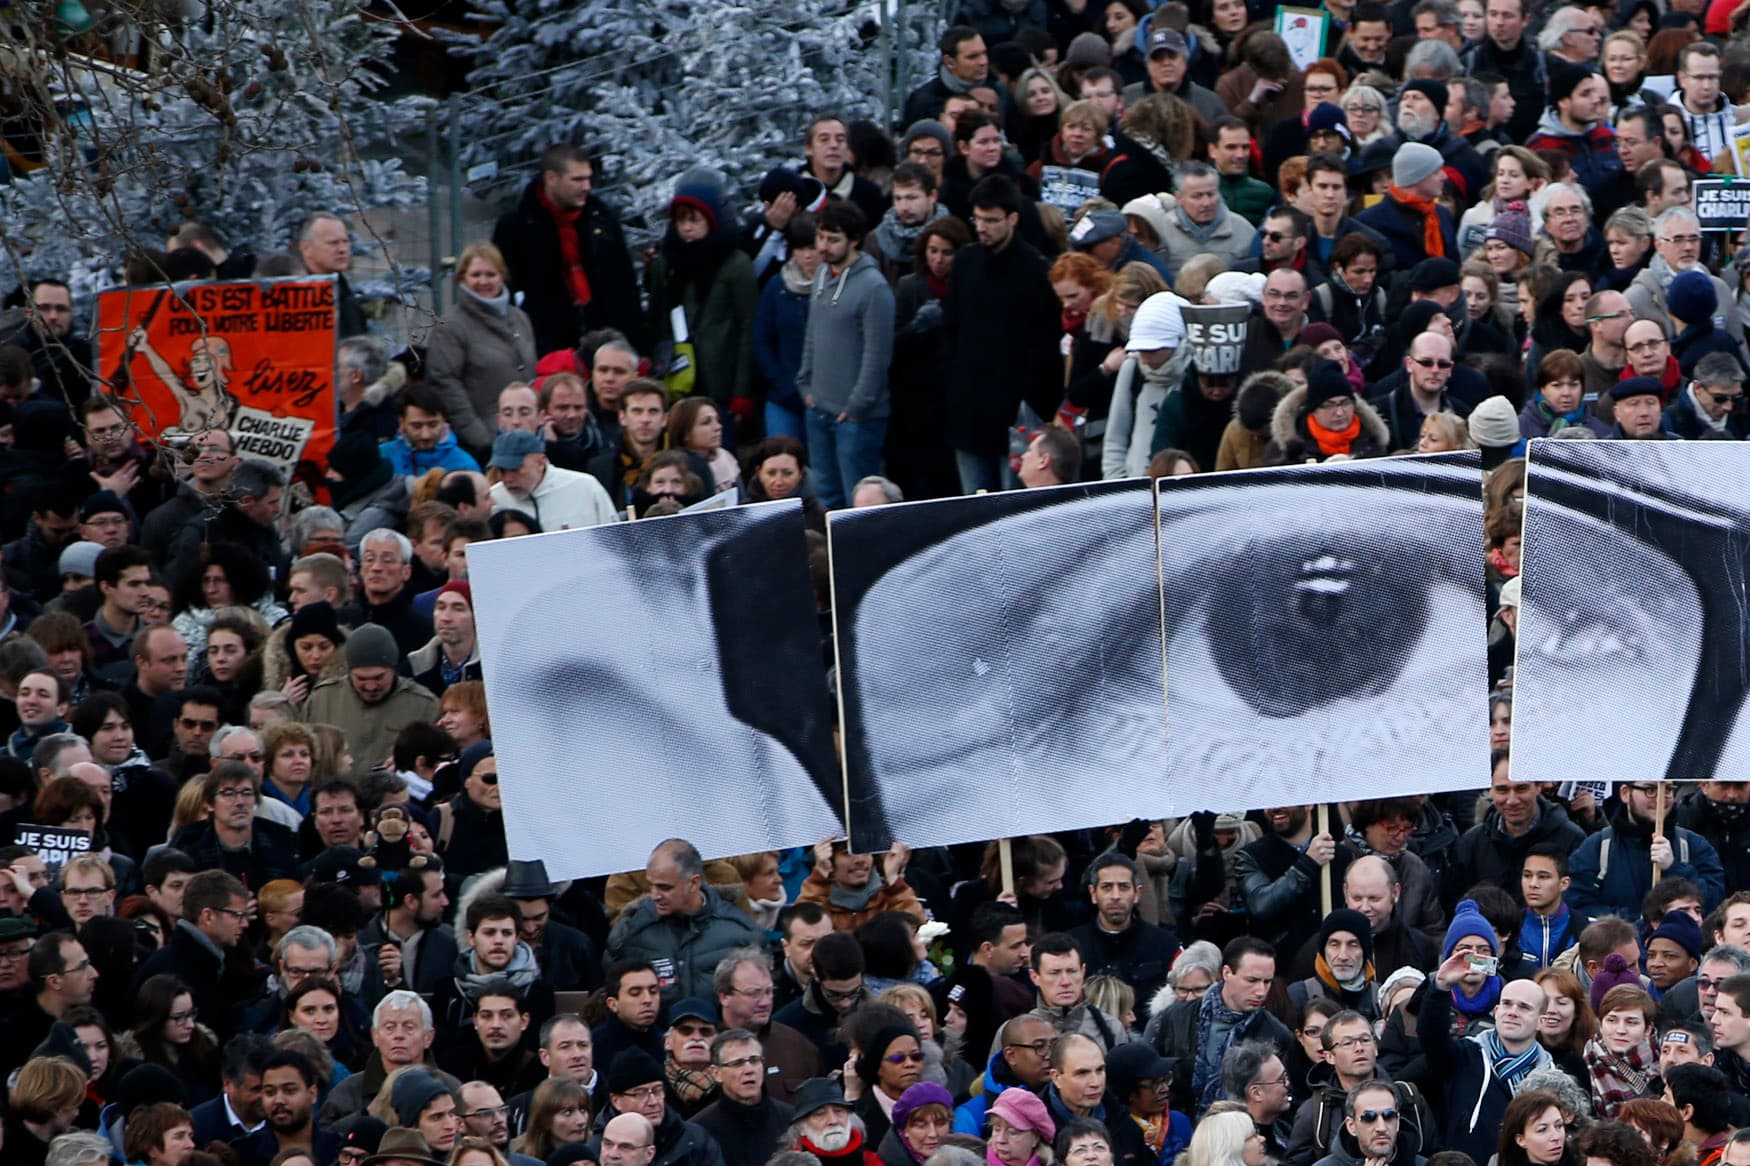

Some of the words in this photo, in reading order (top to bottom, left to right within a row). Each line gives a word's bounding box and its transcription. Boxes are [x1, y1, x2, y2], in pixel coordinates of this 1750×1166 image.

[1697, 189, 1726, 202] JE
[261, 284, 335, 310] BATTUS
[237, 416, 304, 442] CHARLIE
[237, 434, 296, 461] HEBDO
[13, 831, 41, 847] JE
[42, 834, 91, 851] SUIS
